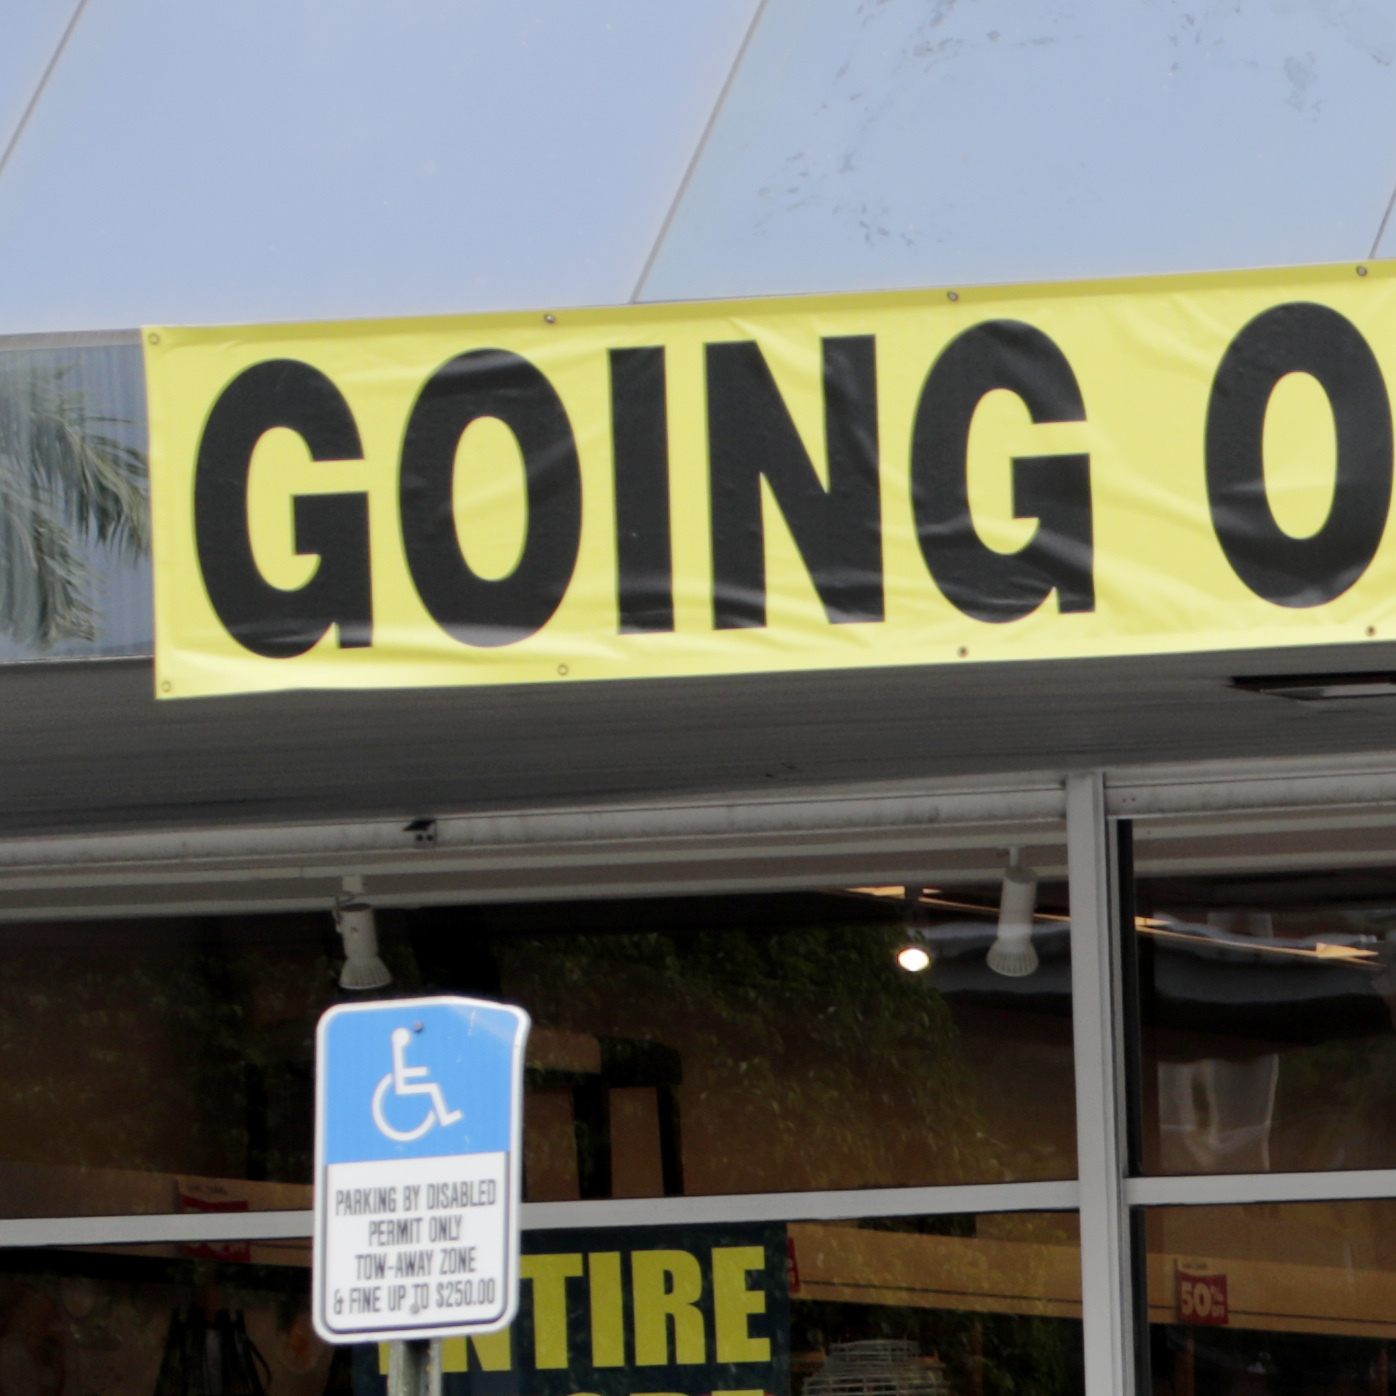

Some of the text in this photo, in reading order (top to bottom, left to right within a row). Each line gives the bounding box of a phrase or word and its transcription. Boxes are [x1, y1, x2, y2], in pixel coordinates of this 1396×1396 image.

[194, 319, 1096, 659] GOING
[335, 1178, 497, 1217] PARKING BY DISABLED
[368, 1215, 462, 1247] PERMIT ONLY
[355, 1246, 476, 1282] TOW-AWAY ZONE
[333, 1277, 496, 1316] & FINE UP TO $250.00
[379, 1245, 771, 1376] TIRE
